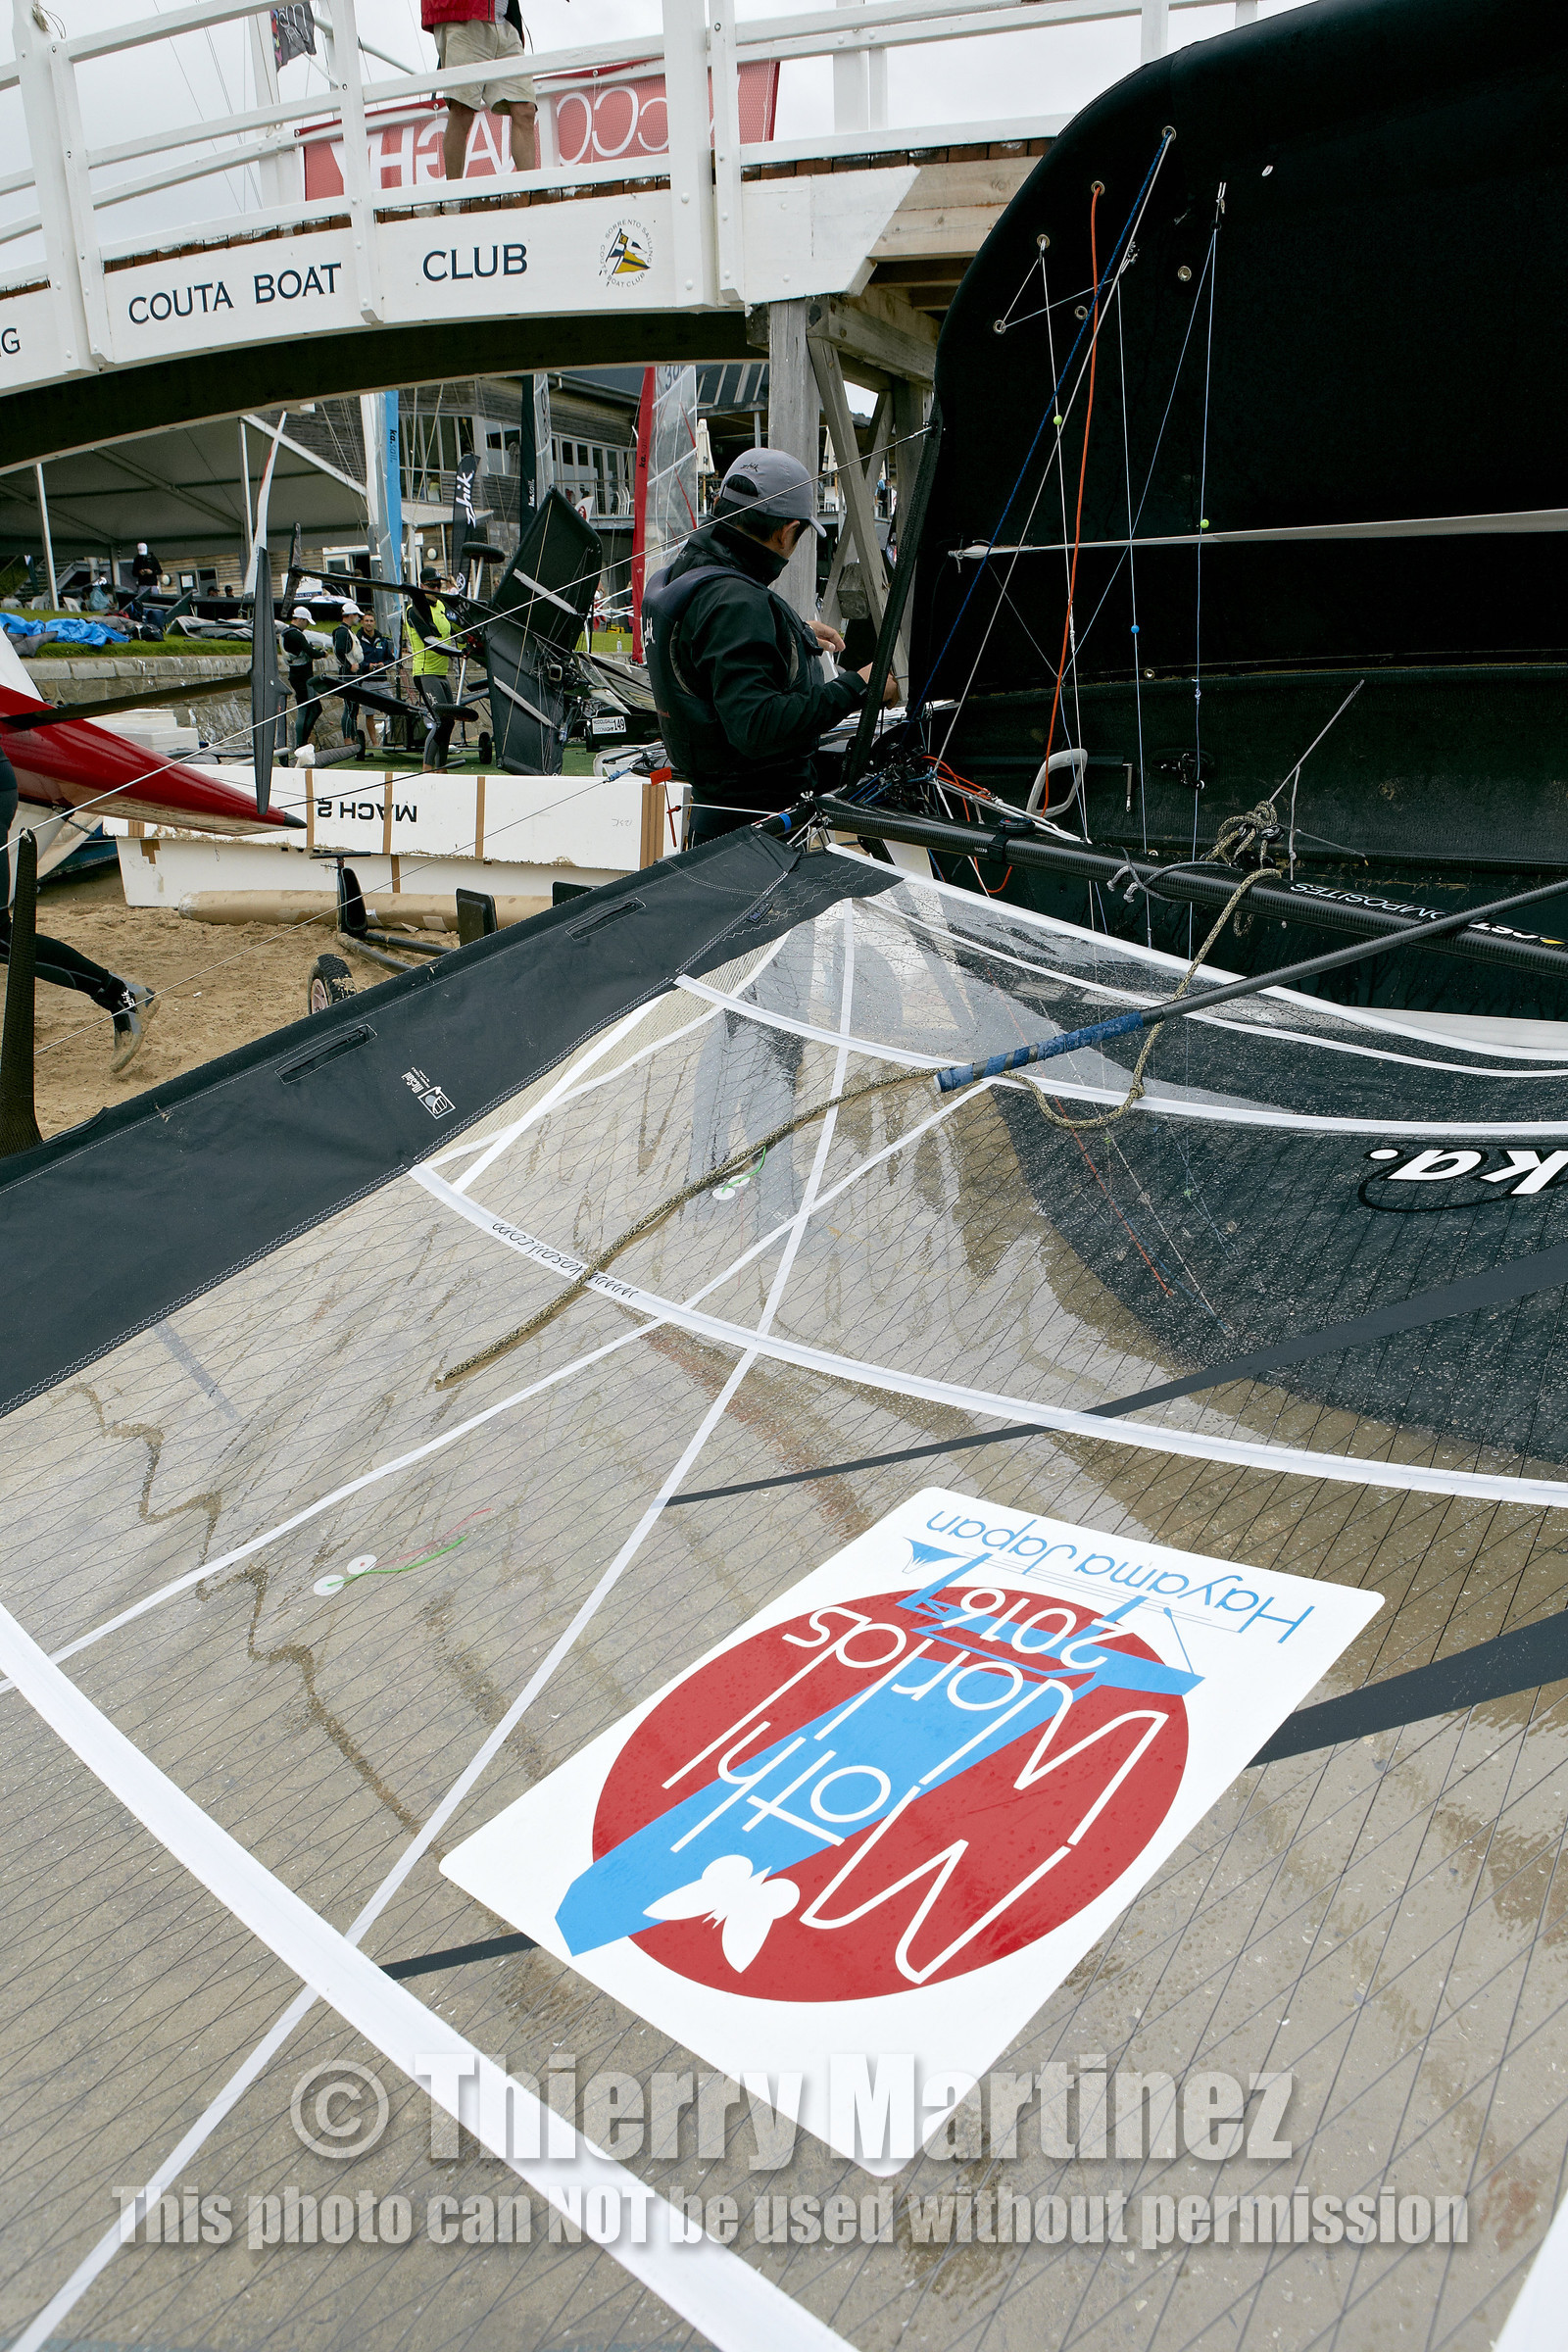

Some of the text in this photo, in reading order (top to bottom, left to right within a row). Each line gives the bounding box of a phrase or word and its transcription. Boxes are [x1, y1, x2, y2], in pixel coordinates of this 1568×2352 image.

[605, 219, 654, 264] SORRENTO SAILING
[128, 243, 528, 324] COUTA BOAT CLUB
[608, 274, 624, 288] BOAT
[627, 272, 646, 288] CLUB
[0, 327, 22, 357] G
[456, 470, 477, 529] zhik
[613, 718, 625, 731] 149
[318, 800, 417, 823] MACH 2
[925, 1508, 1315, 1645] Hayama Japan
[941, 1587, 1135, 1670] 2016
[662, 1605, 1170, 1847] Worlds
[670, 1720, 1073, 1985] Moth
